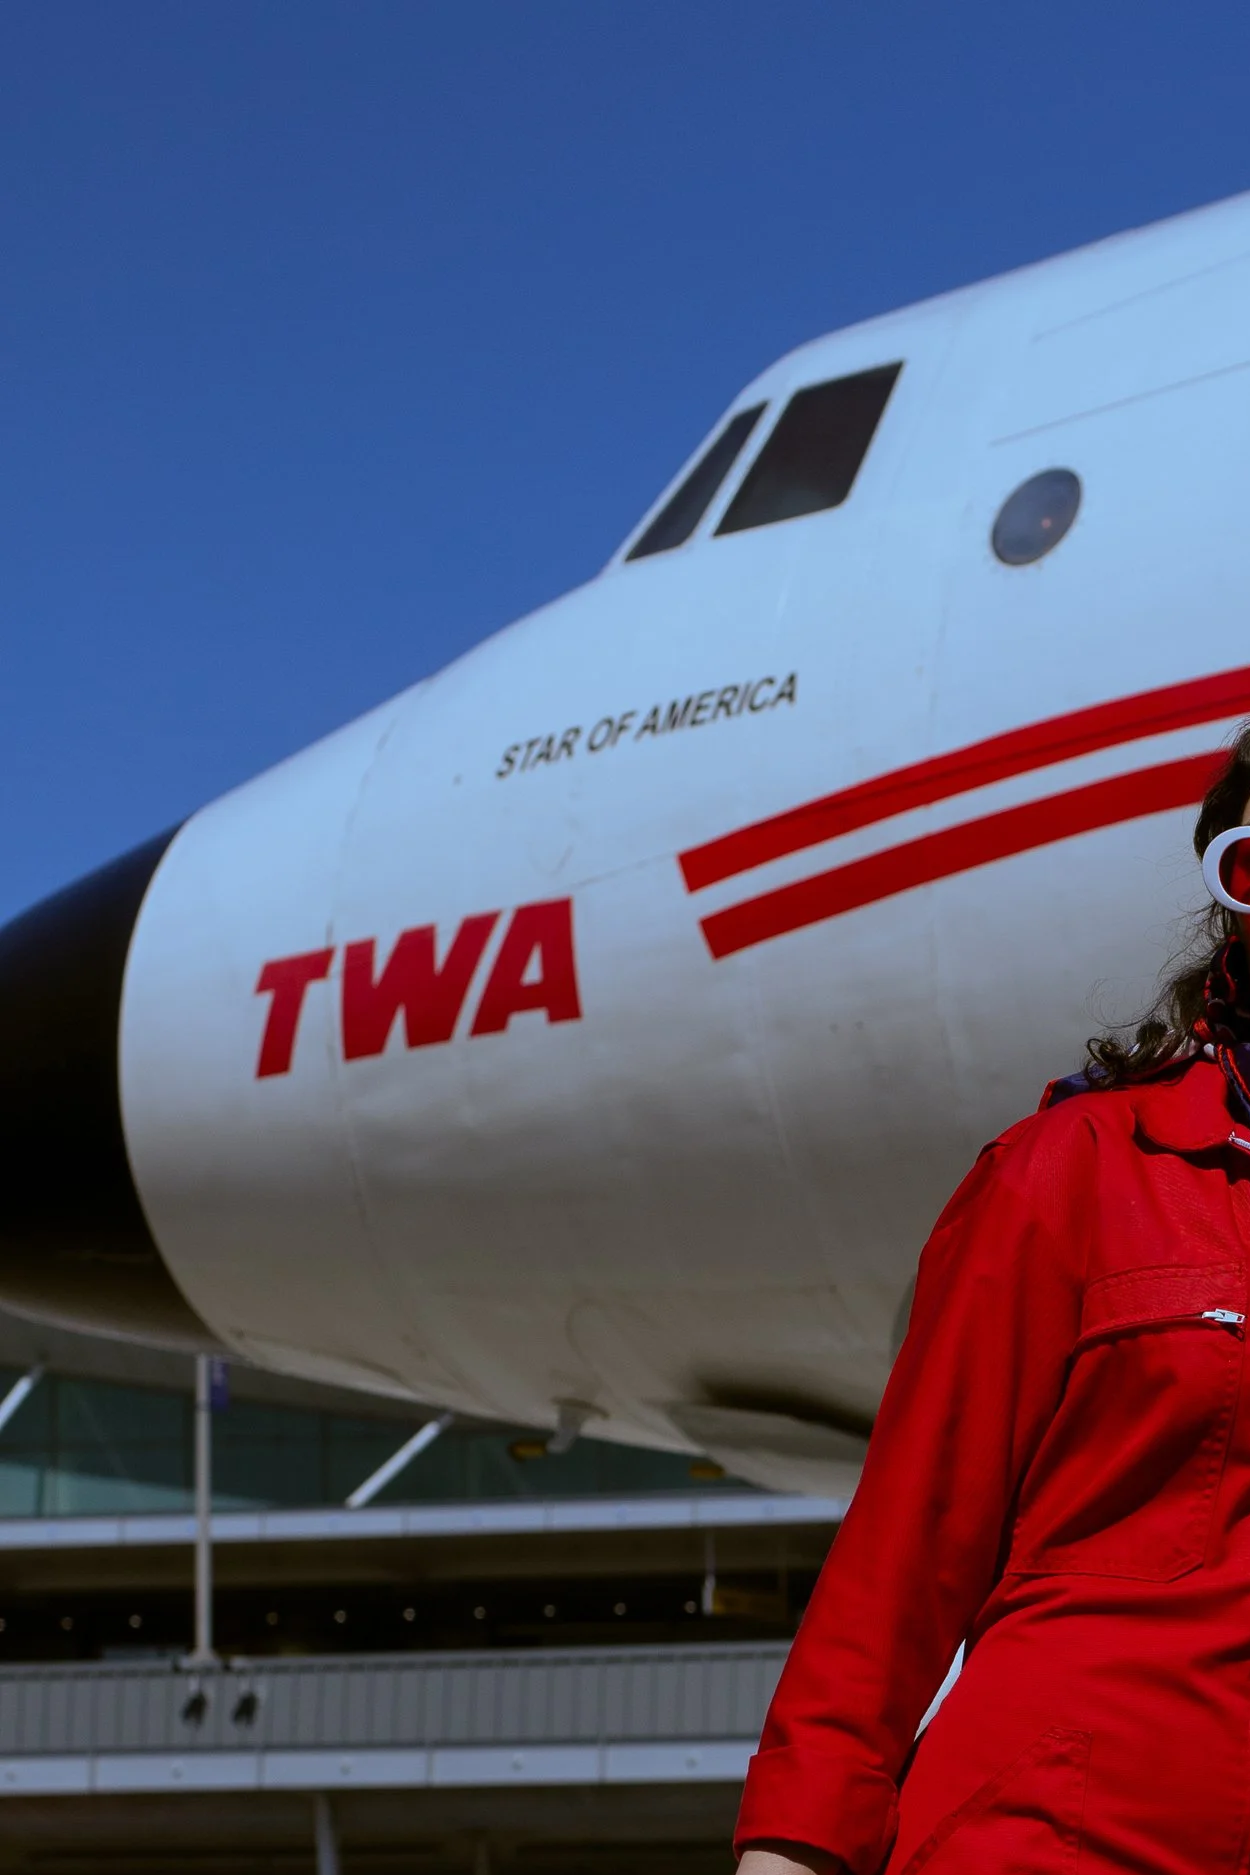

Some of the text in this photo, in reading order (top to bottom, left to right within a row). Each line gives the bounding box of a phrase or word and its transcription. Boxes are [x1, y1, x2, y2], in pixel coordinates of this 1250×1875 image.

[496, 672, 798, 779] STAR OF AMERICA
[255, 897, 582, 1080] TWA
